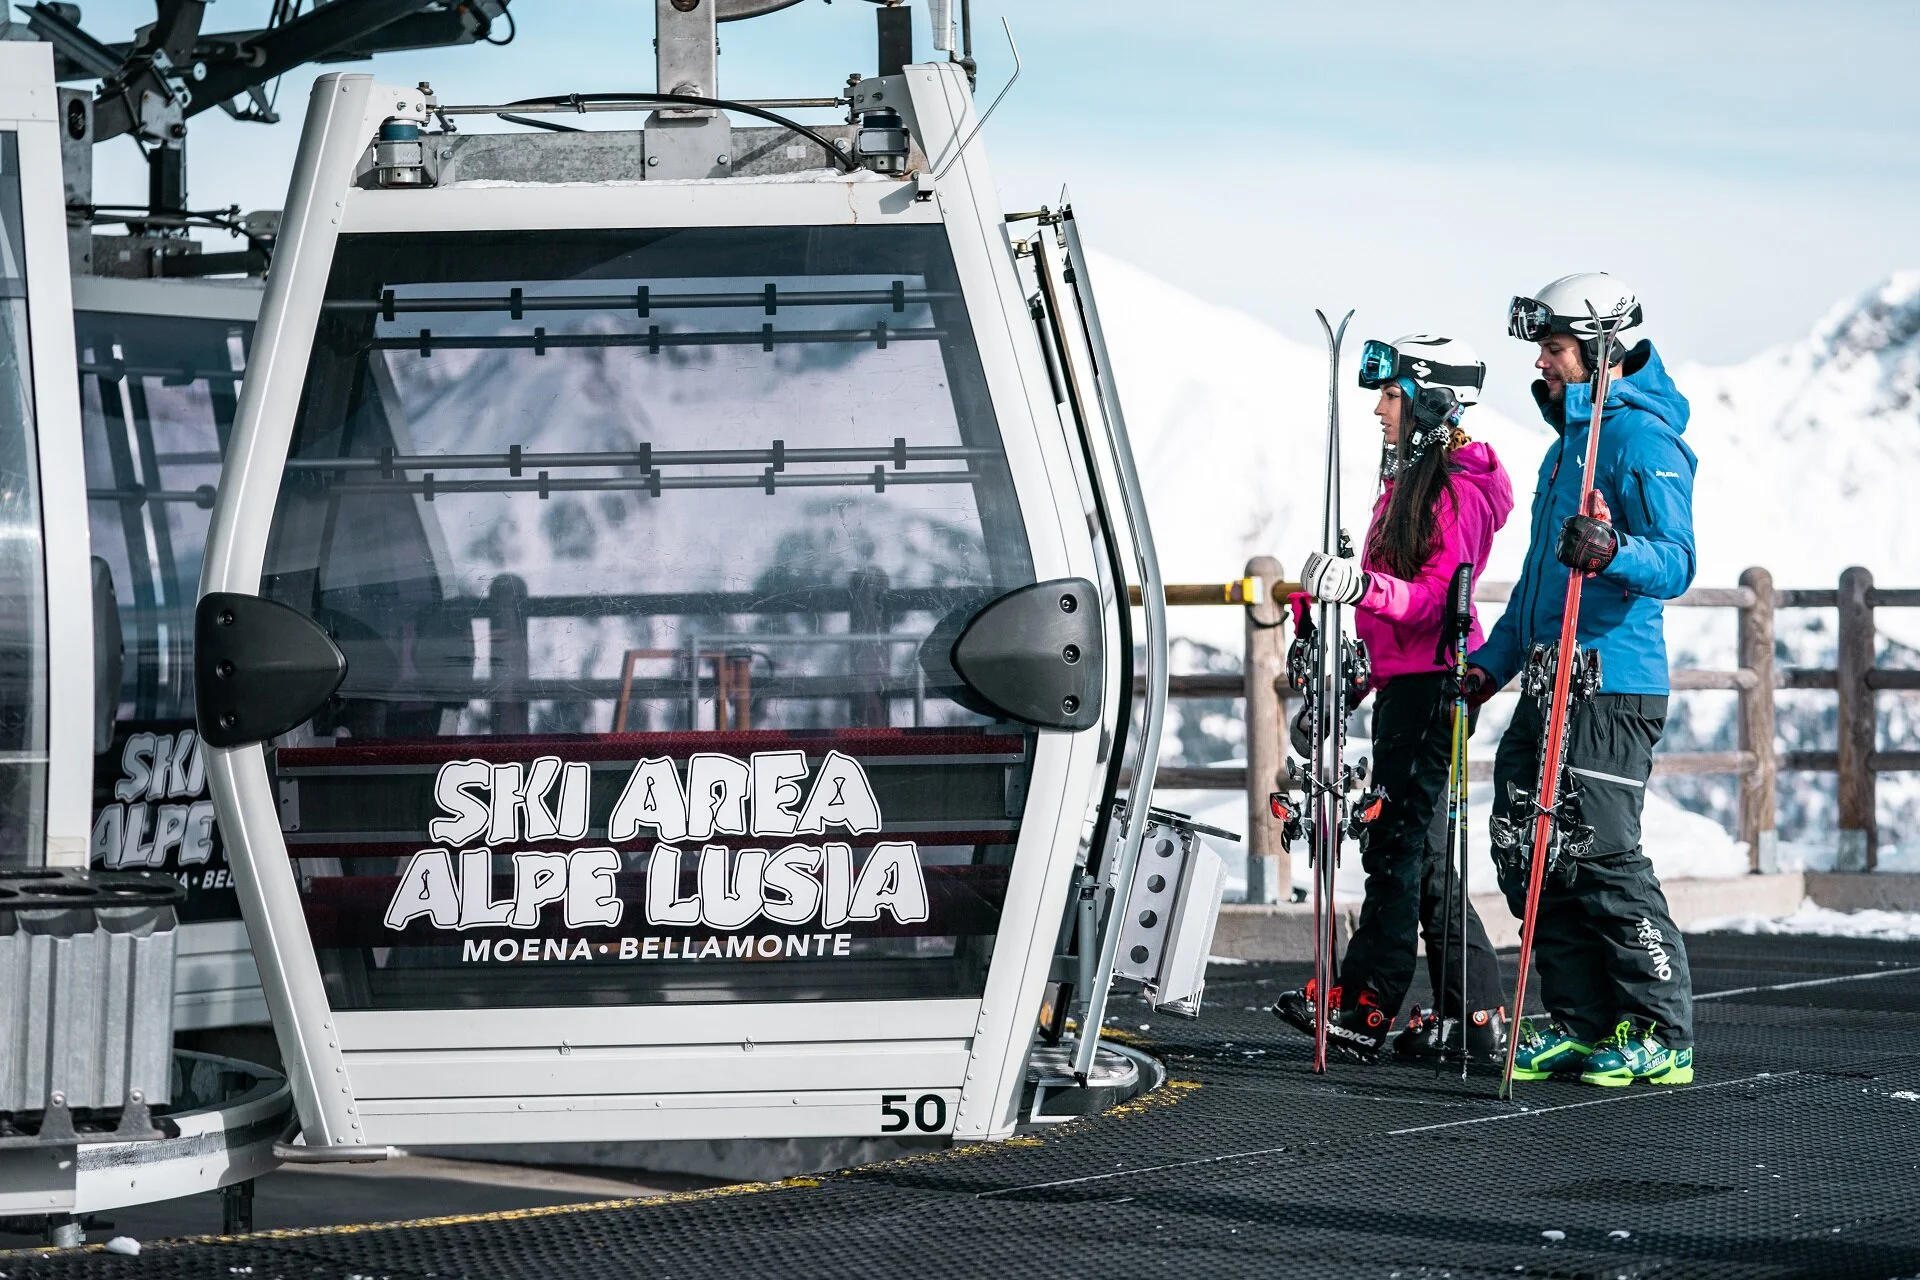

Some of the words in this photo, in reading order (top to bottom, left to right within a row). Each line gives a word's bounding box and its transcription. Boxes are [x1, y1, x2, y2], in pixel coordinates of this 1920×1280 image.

[115, 729, 205, 803] SKI
[429, 756, 591, 846] SKI
[608, 750, 881, 842] AREA
[90, 800, 217, 870] ALPE
[384, 847, 623, 930] ALPE
[646, 841, 929, 929] LUSIA
[462, 938, 593, 962] MOENA
[619, 933, 852, 960] BELLAMONTE
[1635, 917, 1672, 981] TRENTINO
[1325, 1020, 1377, 1047] ORDICA
[881, 1093, 947, 1133] 50
